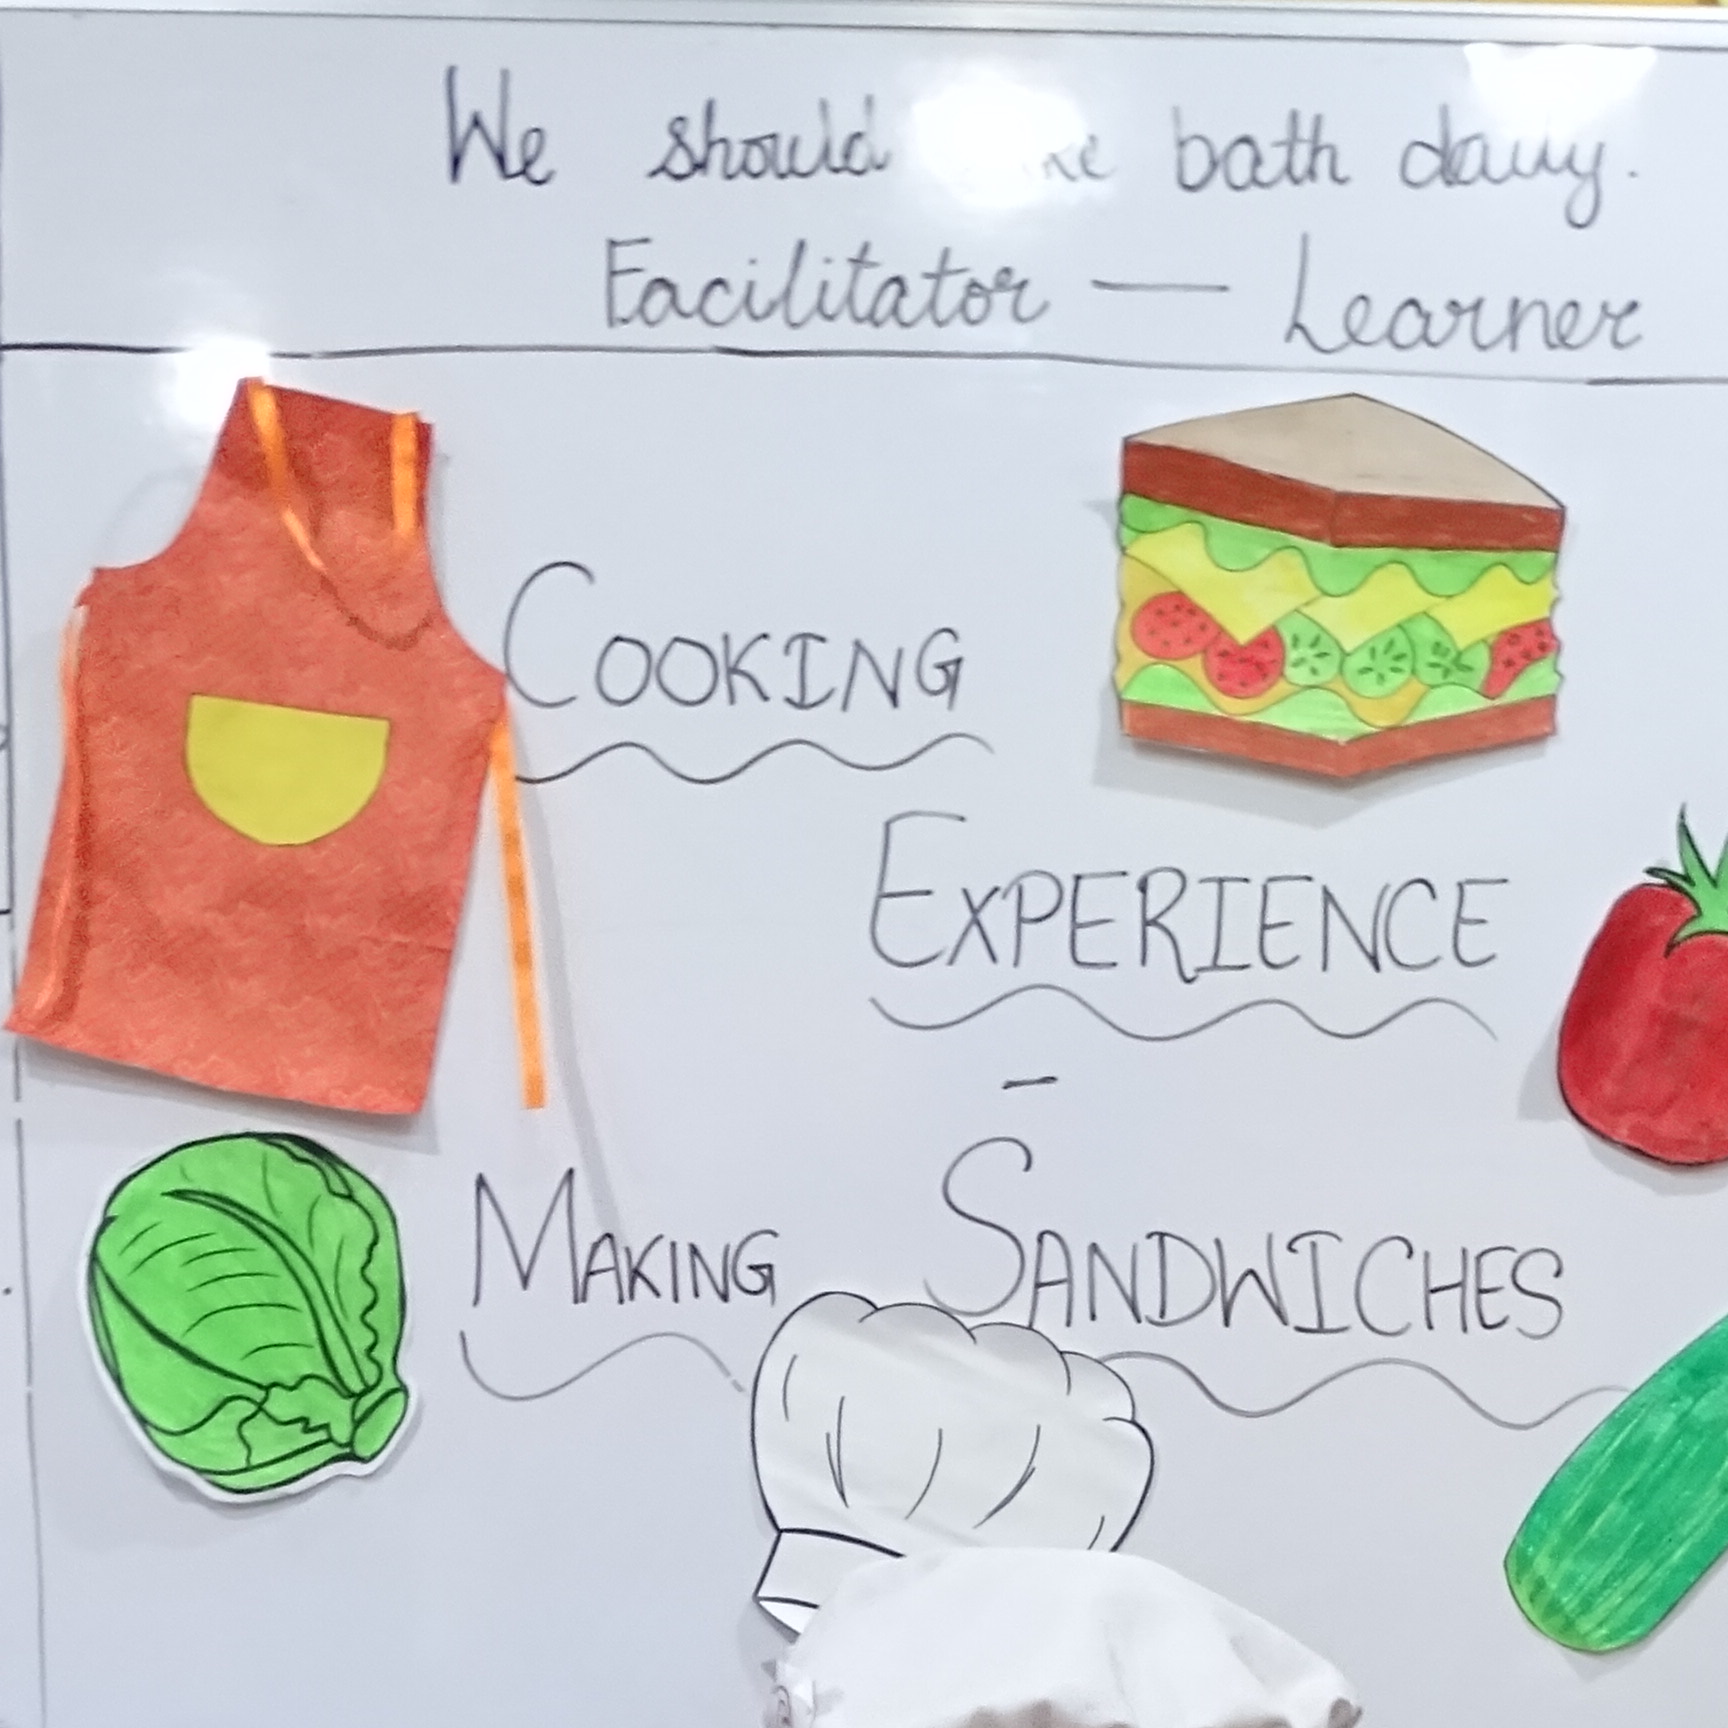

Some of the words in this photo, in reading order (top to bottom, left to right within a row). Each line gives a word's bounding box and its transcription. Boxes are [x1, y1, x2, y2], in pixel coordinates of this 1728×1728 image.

[444, 64, 556, 186] We
[647, 93, 893, 181] should
[1172, 103, 1351, 193] bath
[606, 237, 1051, 330] Facilitator
[1284, 231, 1643, 355] Learner
[502, 560, 964, 713] COOKING
[869, 809, 1509, 985] EXPERIENCE
[472, 1166, 780, 1307] MAKING
[924, 1136, 1564, 1340] SANDWICHES
